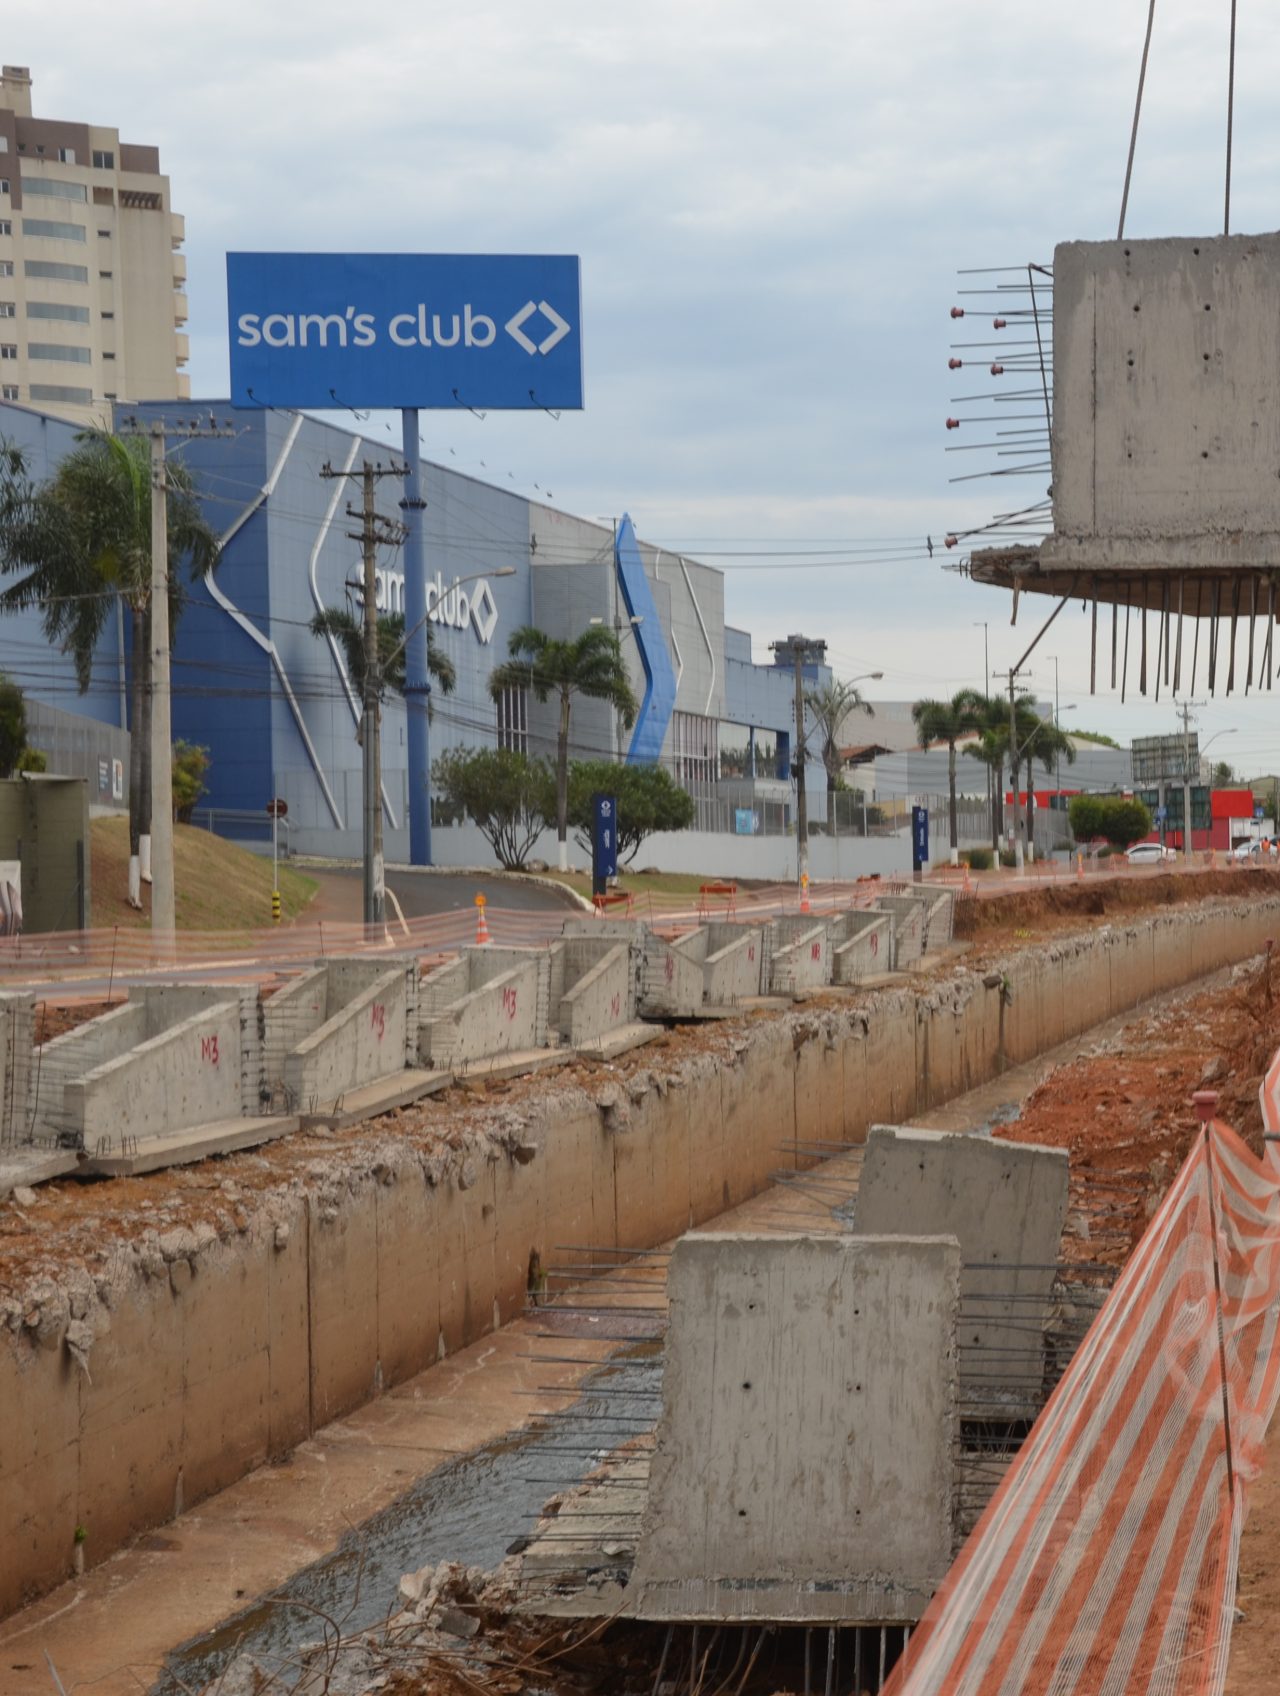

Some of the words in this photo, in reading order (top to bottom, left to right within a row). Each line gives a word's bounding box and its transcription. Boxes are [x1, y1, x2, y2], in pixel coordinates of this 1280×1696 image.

[237, 306, 377, 348] sam's
[388, 303, 497, 348] club
[424, 570, 471, 630] club
[371, 1002, 385, 1041] M3
[503, 987, 517, 1023] M3
[201, 1036, 219, 1064] M3
